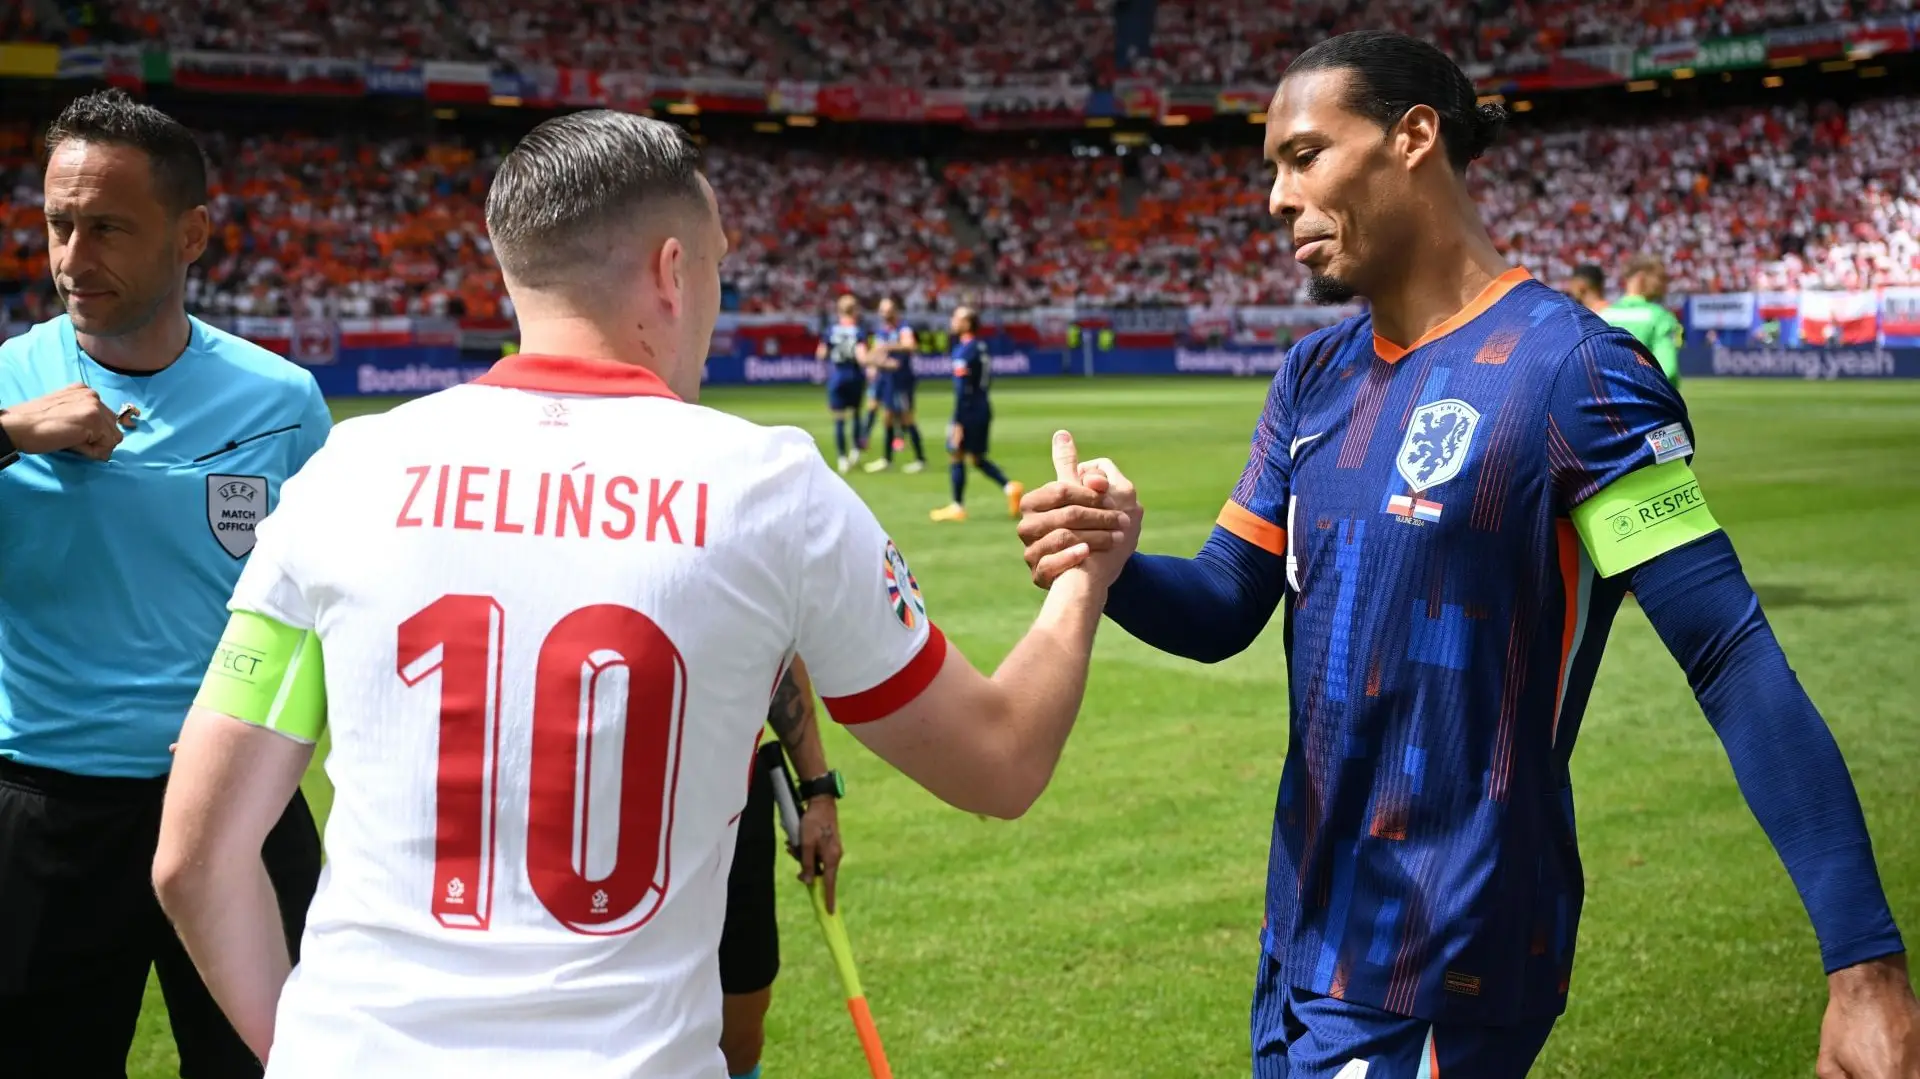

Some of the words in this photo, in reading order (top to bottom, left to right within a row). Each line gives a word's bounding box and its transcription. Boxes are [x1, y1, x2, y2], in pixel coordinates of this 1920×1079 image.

[220, 484, 255, 501] UEFA
[395, 461, 709, 548] ZIELIŃSKI
[1638, 485, 1700, 522] RESPEC
[217, 521, 257, 532] OFFICIA
[221, 509, 256, 520] MATCH
[396, 594, 688, 937] 10
